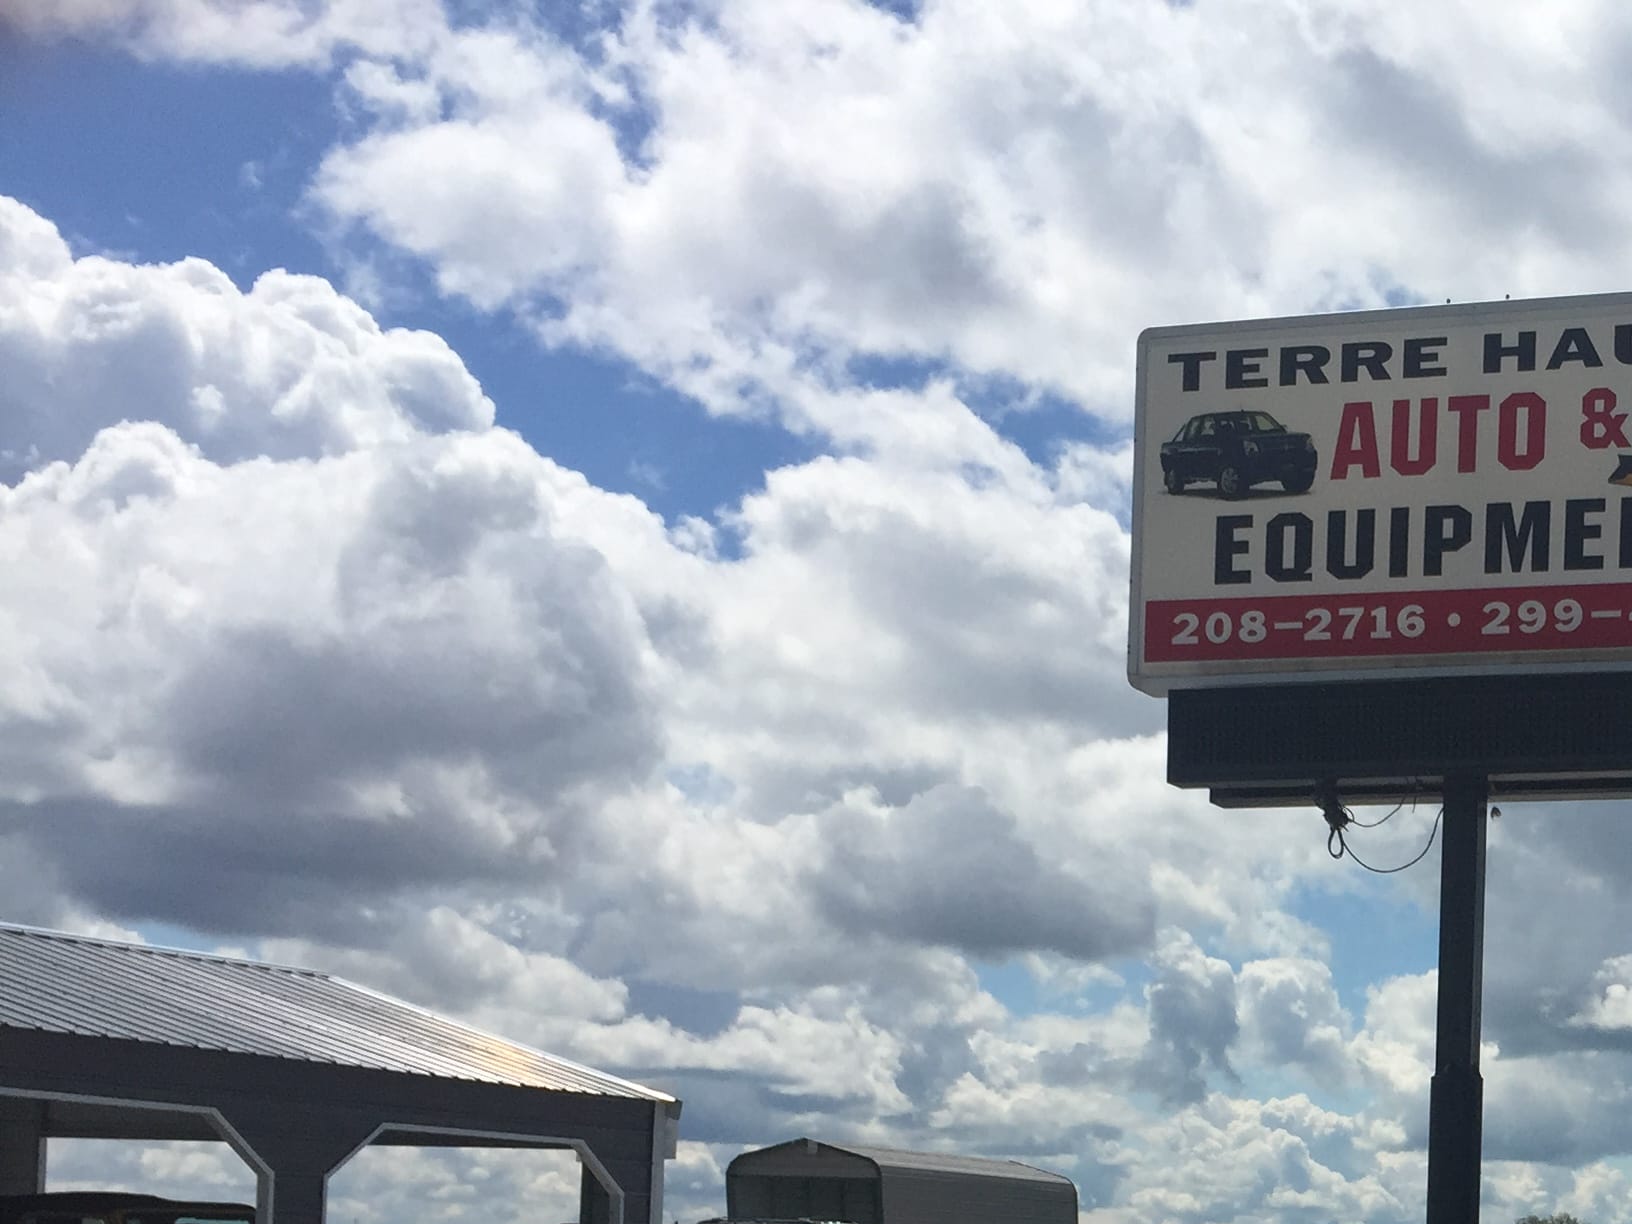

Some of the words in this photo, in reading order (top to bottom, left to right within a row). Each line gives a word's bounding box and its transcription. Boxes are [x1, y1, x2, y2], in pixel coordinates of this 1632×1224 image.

[1168, 337, 1448, 392] TERRE
[1330, 391, 1546, 480] AUTO
[1580, 387, 1632, 449] &
[1171, 604, 1426, 645] 208-2716
